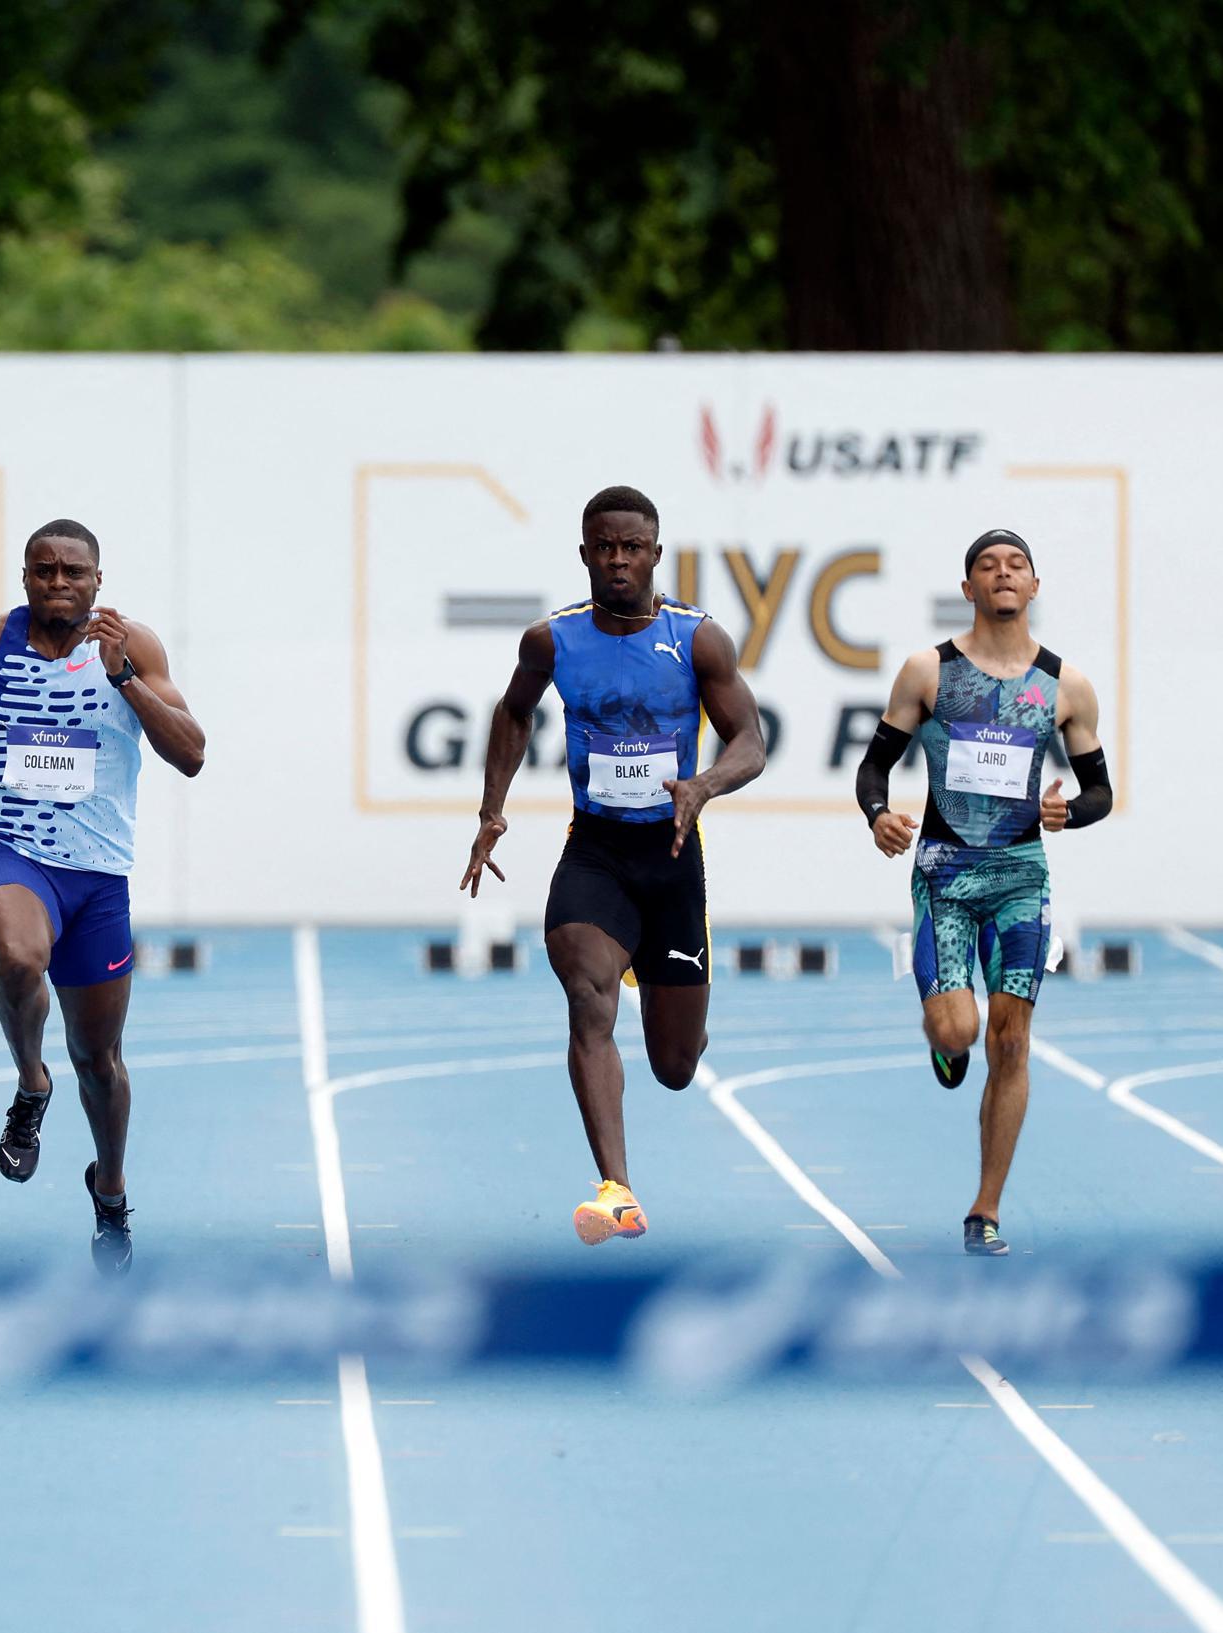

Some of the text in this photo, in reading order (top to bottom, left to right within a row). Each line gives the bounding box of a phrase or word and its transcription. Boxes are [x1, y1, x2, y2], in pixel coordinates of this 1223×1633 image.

[788, 433, 981, 472] USATF
[31, 730, 70, 746] xfinity
[975, 728, 1013, 743] xfinity
[613, 741, 650, 755] xfinity
[24, 754, 75, 771] COLEMAN
[977, 751, 1007, 766] LAIRD
[615, 764, 650, 778] BLAKE
